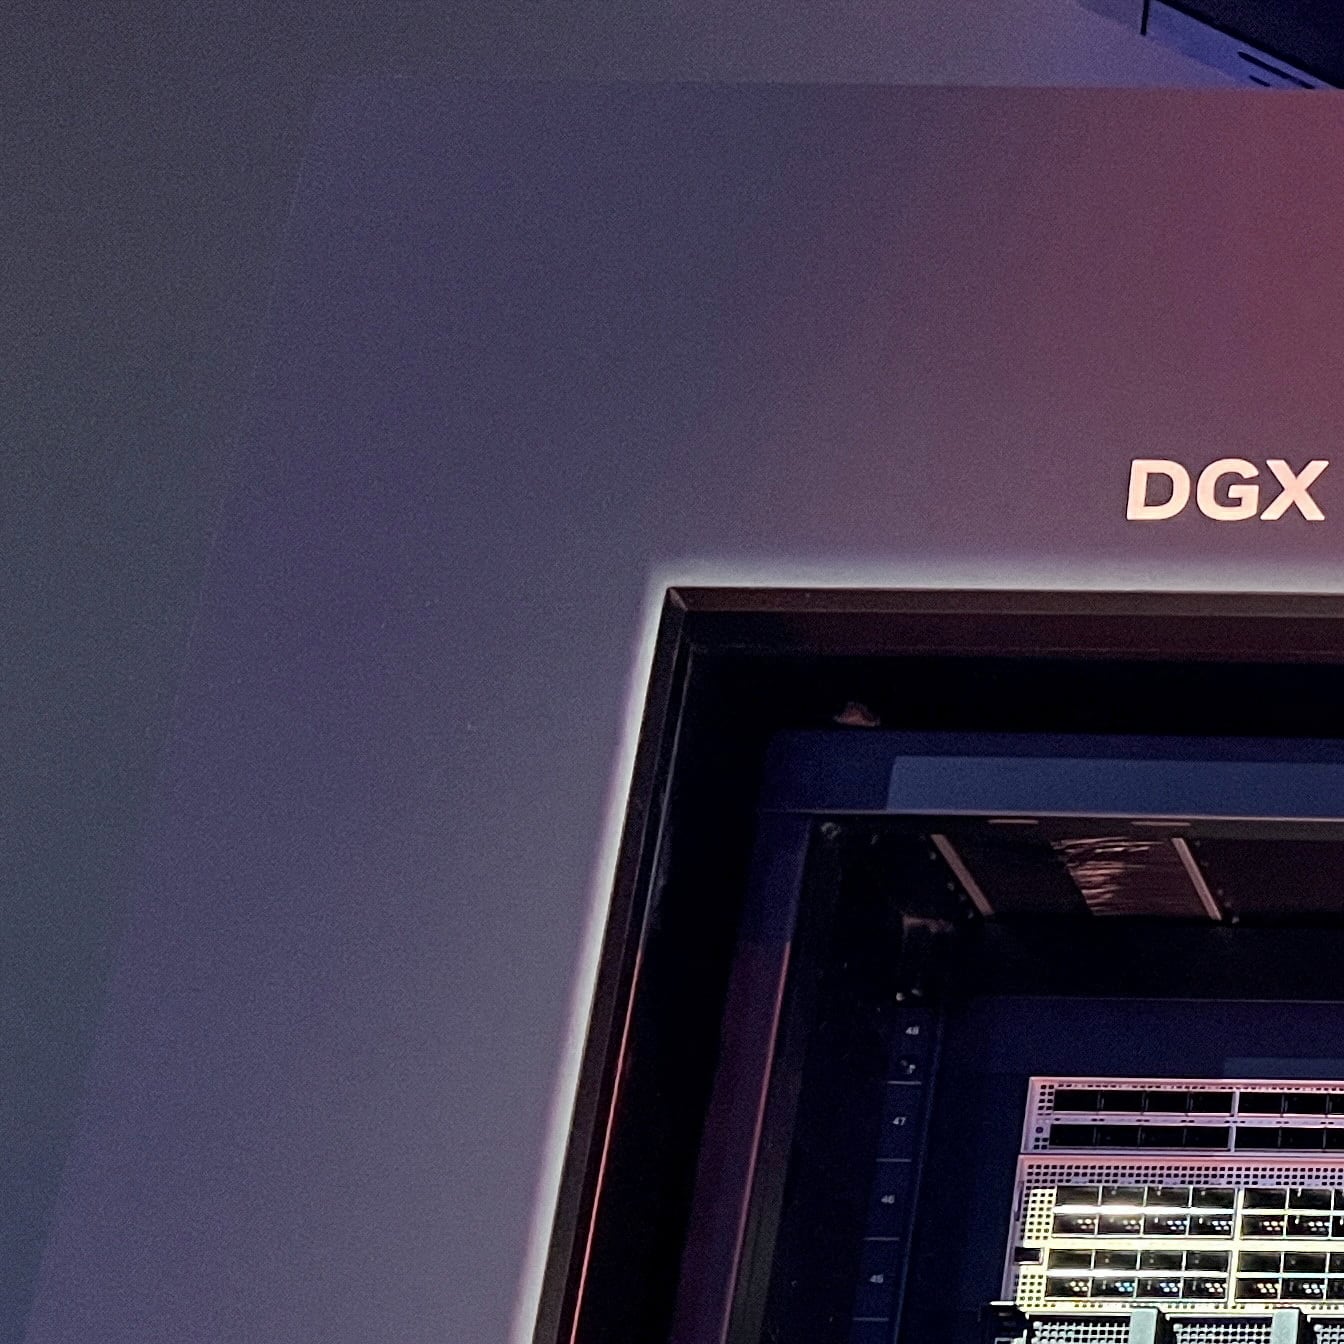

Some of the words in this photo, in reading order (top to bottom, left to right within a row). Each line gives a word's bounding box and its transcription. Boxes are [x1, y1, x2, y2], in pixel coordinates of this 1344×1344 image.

[1126, 458, 1329, 521] DGX
[892, 1116, 906, 1126] 47
[881, 1195, 895, 1204] 46
[869, 1274, 884, 1284] 45
